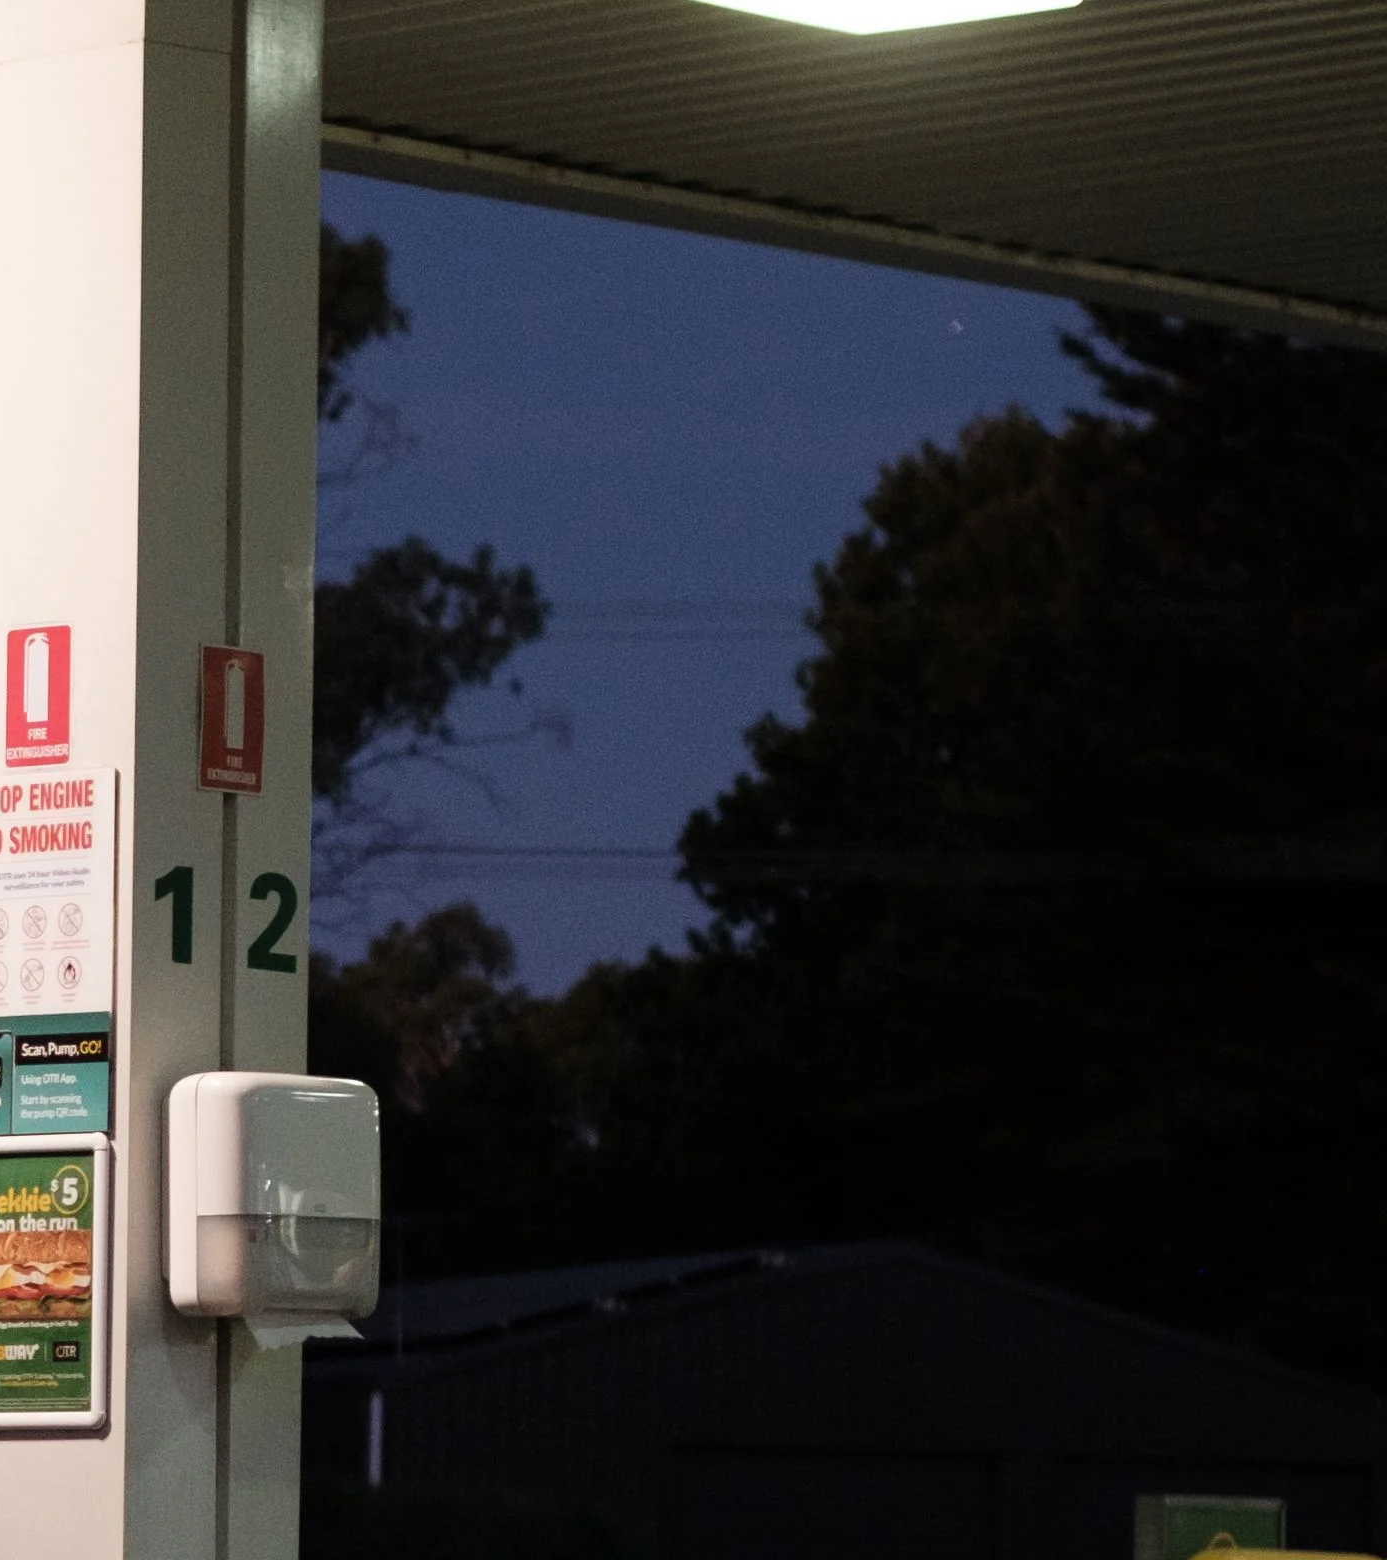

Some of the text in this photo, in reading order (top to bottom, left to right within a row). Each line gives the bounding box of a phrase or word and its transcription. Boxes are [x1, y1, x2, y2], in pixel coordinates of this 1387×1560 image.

[28, 727, 48, 740] FIRE
[6, 743, 69, 760] EXTINGUISHER
[29, 779, 95, 811] ENGINE
[9, 821, 93, 854] SMOKING
[154, 865, 194, 964] 1
[247, 872, 298, 974] 2
[21, 1040, 102, 1058] Scan, Pump, GO!
[19, 1213, 47, 1232] the
[50, 1217, 78, 1232] run
[55, 1345, 78, 1358] OTR
